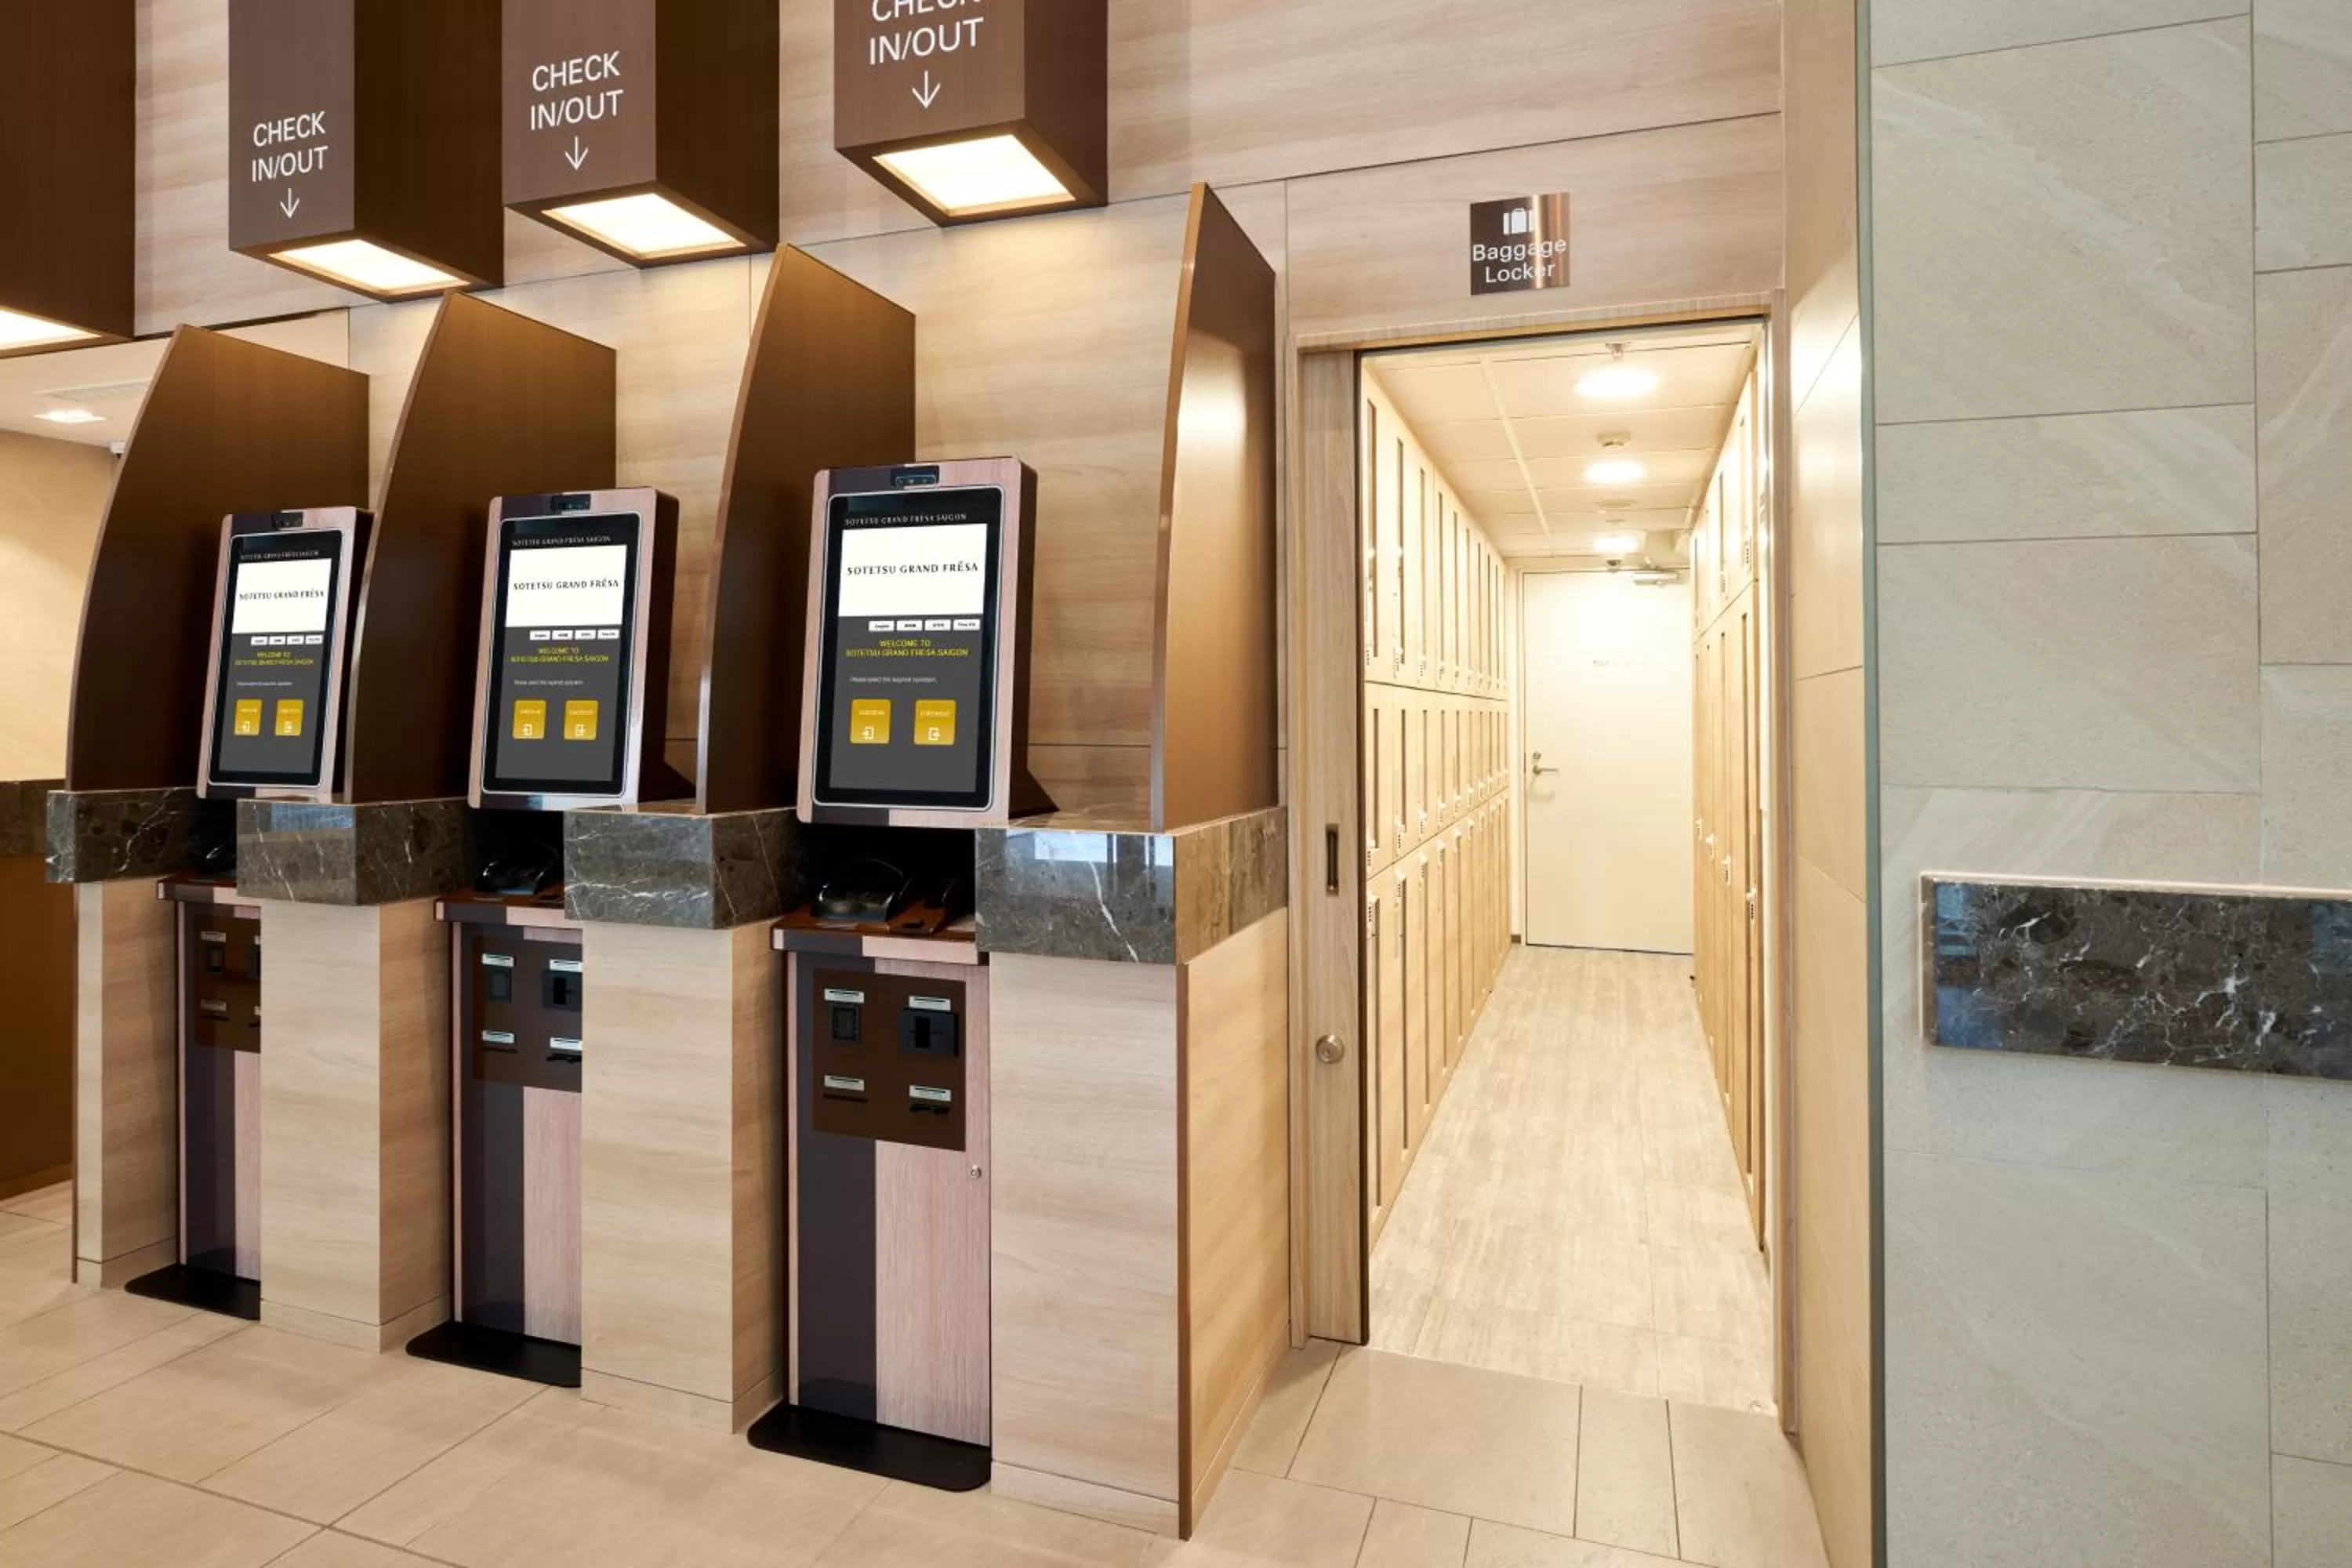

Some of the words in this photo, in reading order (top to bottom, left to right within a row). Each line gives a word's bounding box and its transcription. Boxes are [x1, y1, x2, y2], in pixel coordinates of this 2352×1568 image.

[872, 0, 981, 21] CHE
[869, 16, 984, 65] IN/OUT
[532, 50, 620, 92] CHECK
[531, 89, 624, 131] IN/OUT
[253, 111, 326, 147] CHECK
[252, 145, 328, 182] IN/OUT
[1472, 238, 1567, 263] Baggage
[847, 565, 897, 576] SOTETSU
[899, 564, 938, 574] GRAND
